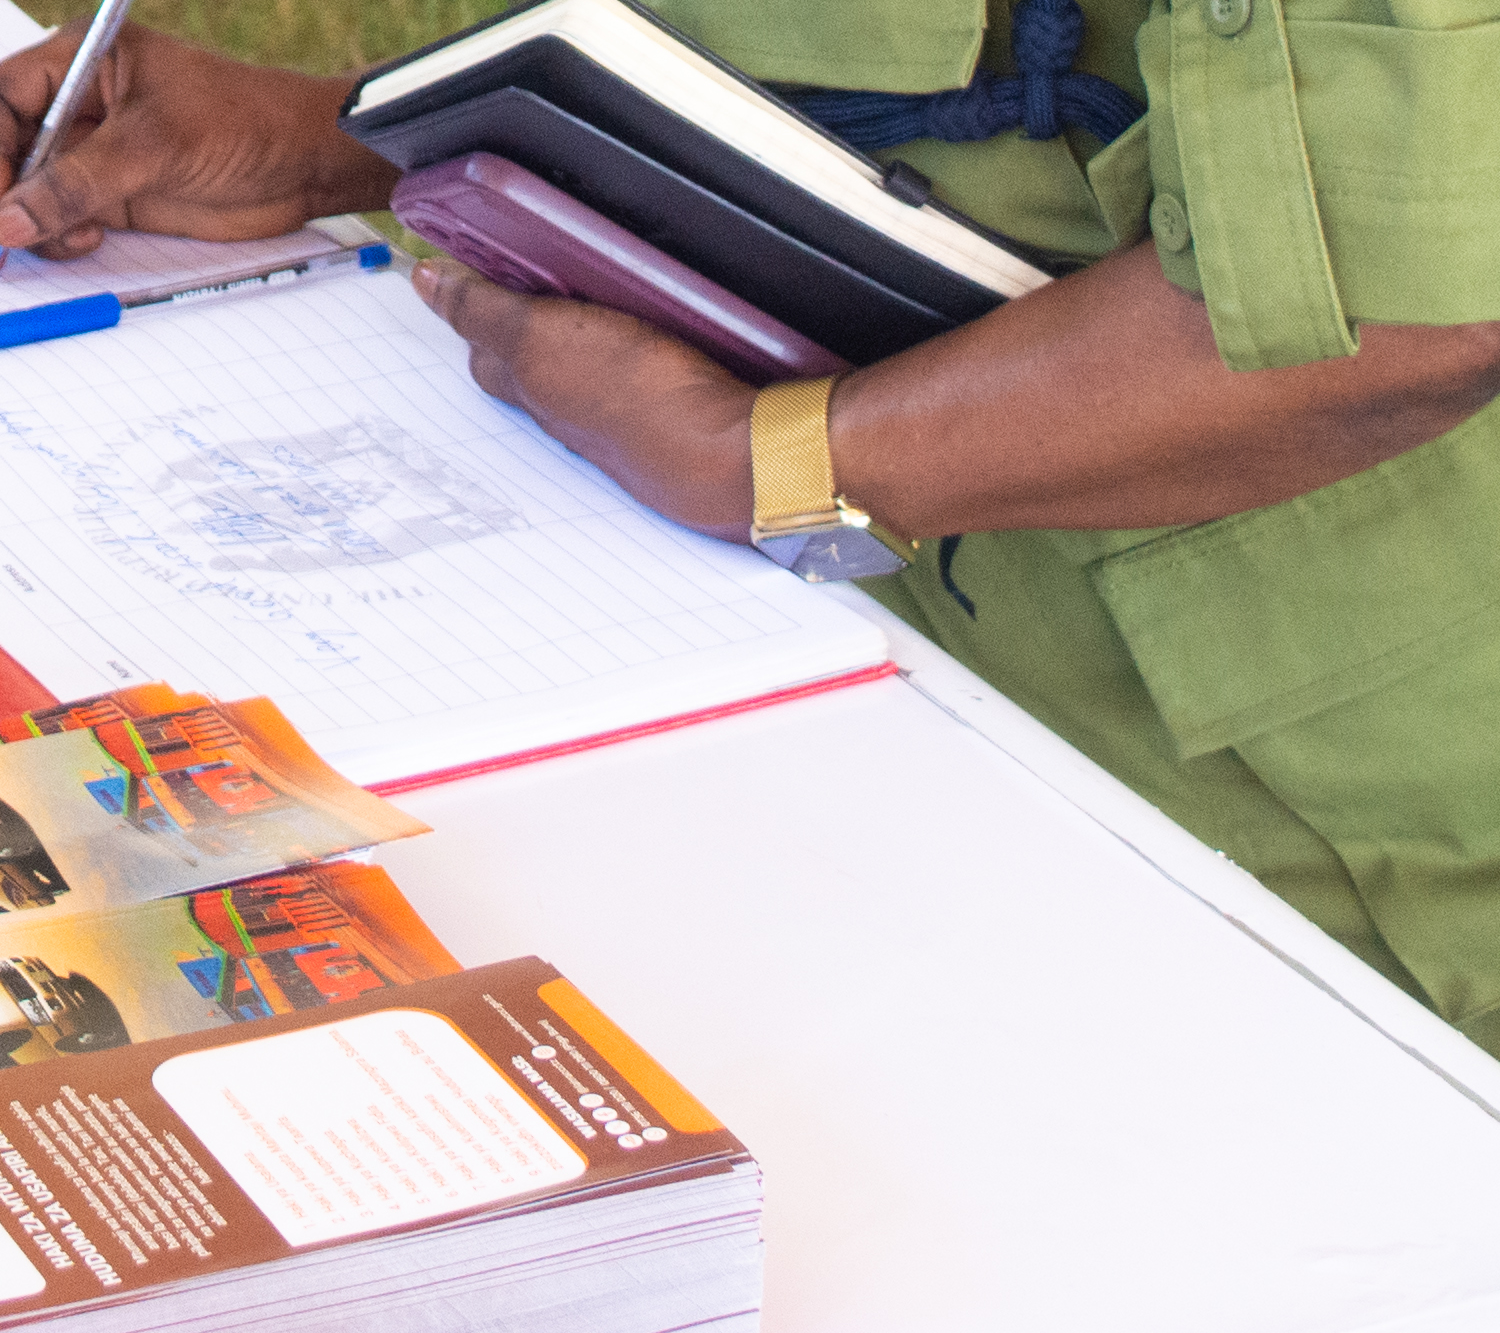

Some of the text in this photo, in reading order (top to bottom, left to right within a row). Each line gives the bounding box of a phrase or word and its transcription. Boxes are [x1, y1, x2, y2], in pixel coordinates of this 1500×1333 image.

[350, 1055, 399, 1096] Mazingira
[387, 1094, 421, 1120] katika
[390, 1028, 534, 1167] Haki ya Kugomea Huduma au Bidhaa
[531, 1080, 601, 1138] WASILIANA
[243, 1119, 287, 1153] Mahitaji
[381, 1123, 423, 1157] Kulipwa
[441, 1148, 463, 1160] ya
[469, 1142, 491, 1154] ya
[273, 1152, 312, 1182] kupata
[299, 1143, 341, 1176] kupewa
[385, 1161, 407, 1173] ya
[413, 1155, 435, 1167] ya
[449, 1160, 479, 1181] Haki
[477, 1153, 507, 1174] Haki
[329, 1174, 351, 1186] ya
[357, 1168, 379, 1180] ya
[393, 1173, 423, 1195] Haki
[421, 1166, 451, 1188] Haki
[273, 1186, 294, 1199] ya
[301, 1180, 323, 1192] ya
[337, 1186, 367, 1208] Haki
[365, 1179, 395, 1201] Haki
[40, 1200, 73, 1223] ZA
[281, 1198, 310, 1219] Haki
[308, 1192, 338, 1213] Haki
[14, 1211, 48, 1234] ZA
[30, 1232, 76, 1269] HAKI
[56, 1221, 124, 1286] HUDUMA
